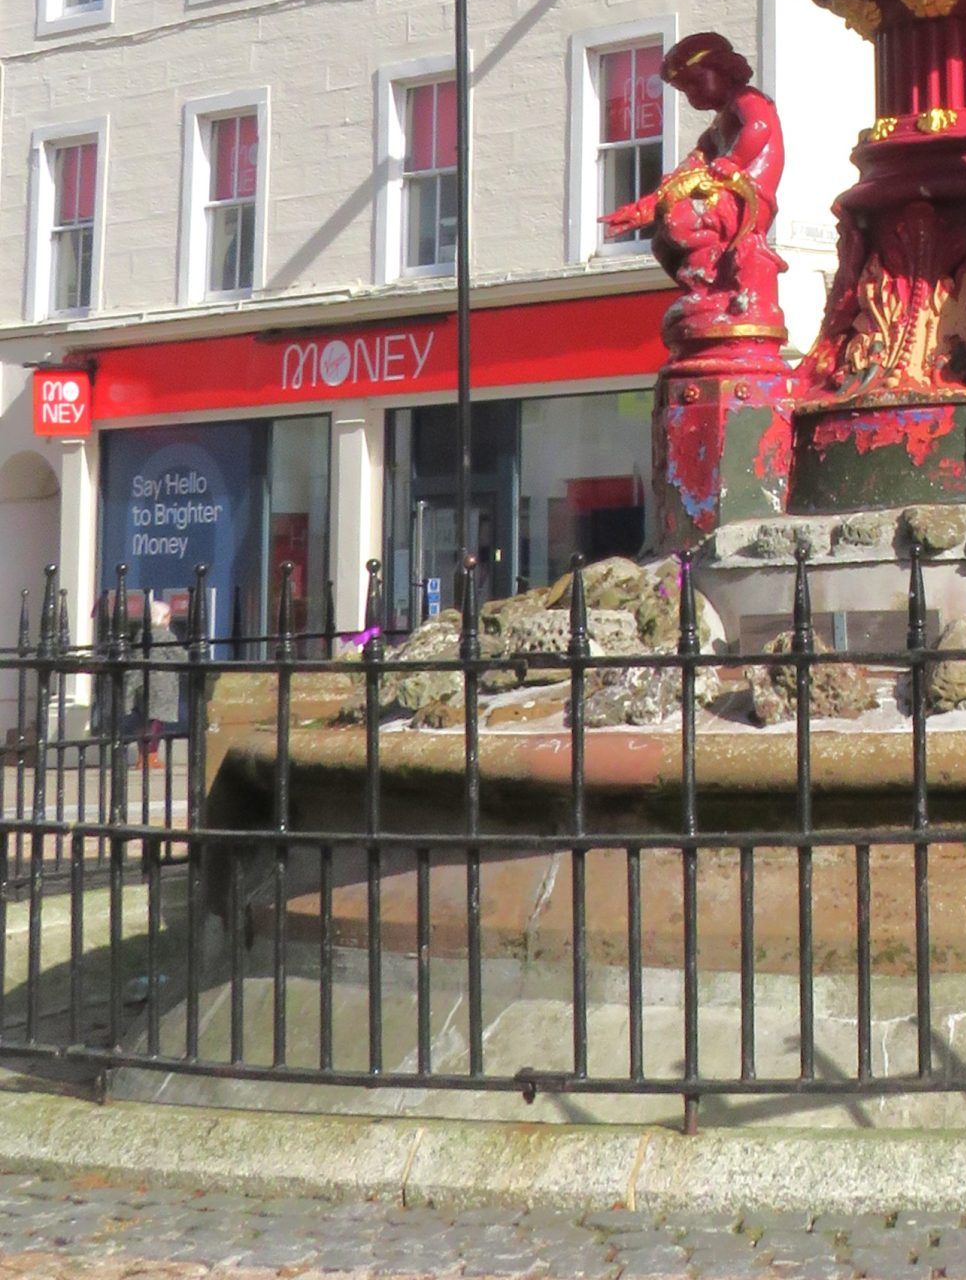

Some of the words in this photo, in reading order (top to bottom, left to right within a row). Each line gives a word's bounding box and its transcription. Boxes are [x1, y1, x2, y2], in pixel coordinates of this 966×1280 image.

[282, 331, 434, 390] MONEY
[42, 402, 85, 423] NEY
[132, 475, 162, 500] Say
[165, 471, 207, 495] Hello
[132, 505, 152, 526] to
[154, 501, 223, 530] Brighter
[132, 533, 188, 559] Money
